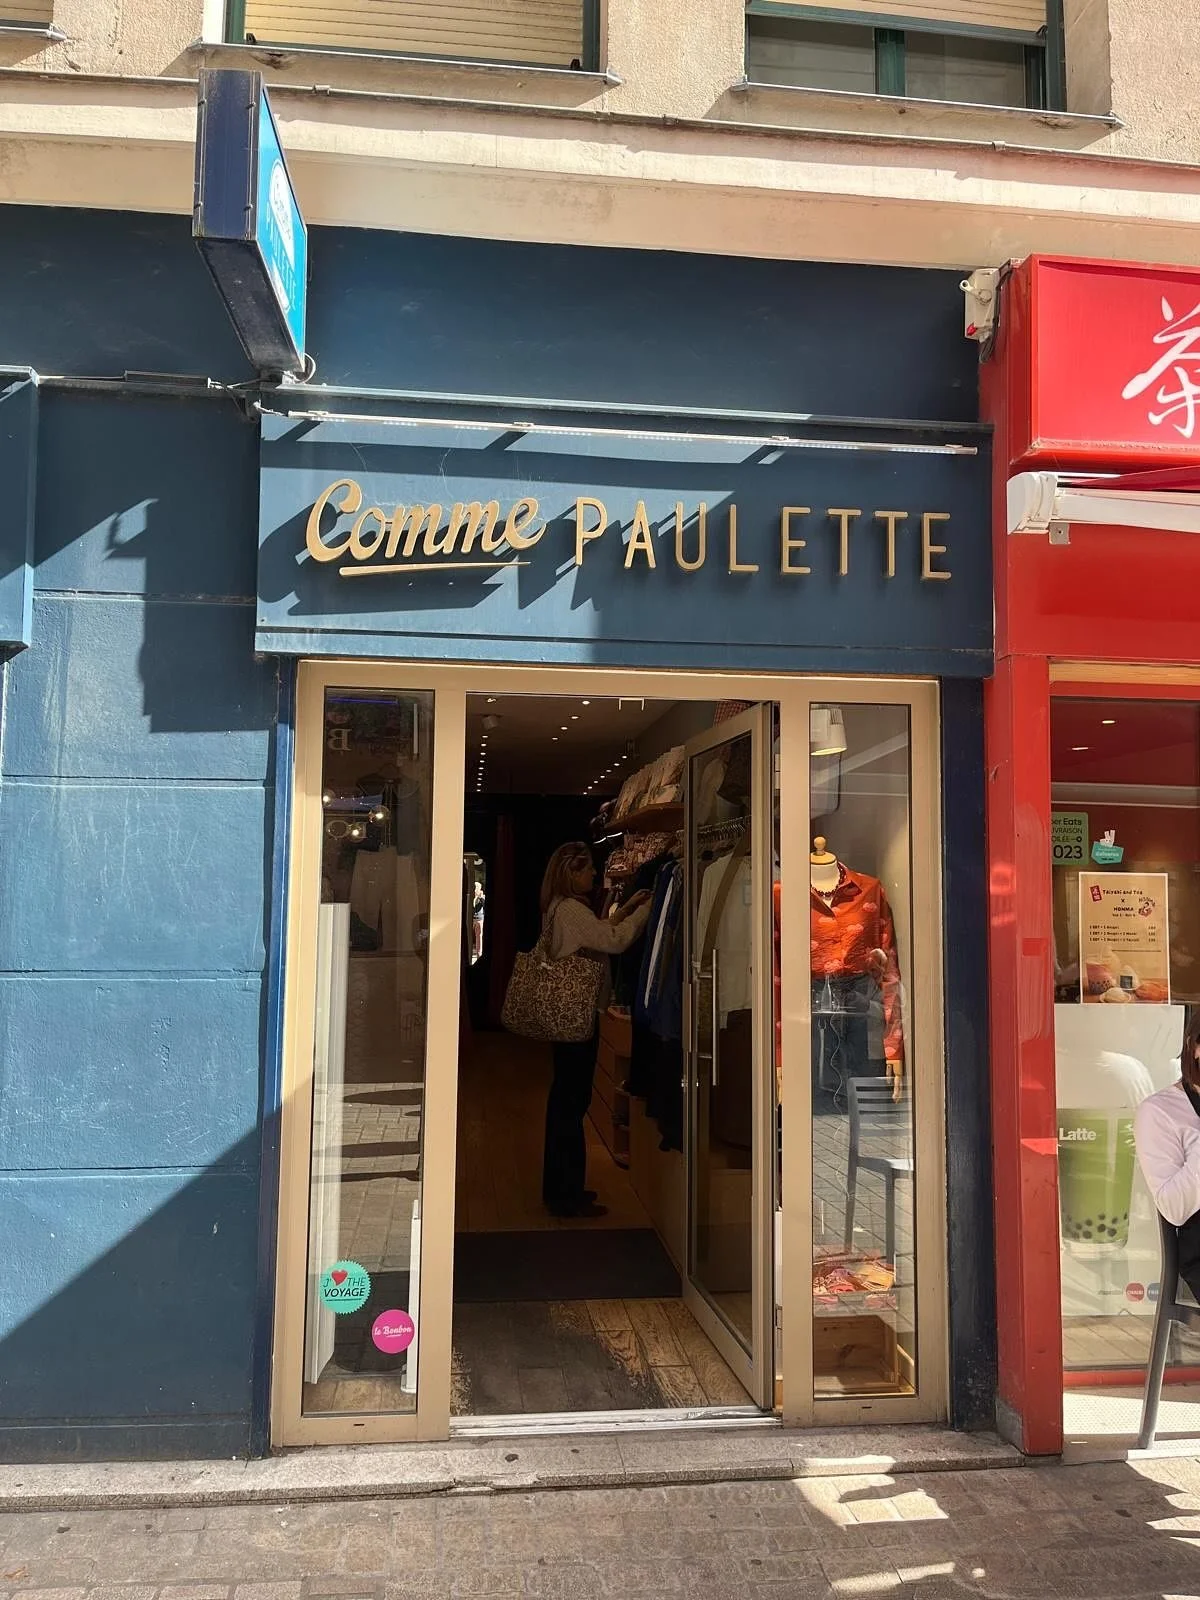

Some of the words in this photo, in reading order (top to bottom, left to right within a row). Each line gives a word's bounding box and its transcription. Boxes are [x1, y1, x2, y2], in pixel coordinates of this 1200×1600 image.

[305, 477, 548, 563] Comme
[575, 496, 952, 581] PAULETTE
[1063, 817, 1082, 826] Eats
[1051, 827, 1083, 835] IVRAISON
[1053, 844, 1083, 860] 023
[1058, 1127, 1097, 1141] Latte
[323, 1287, 366, 1298] VOYAGE
[383, 1324, 412, 1335] Bonbon
